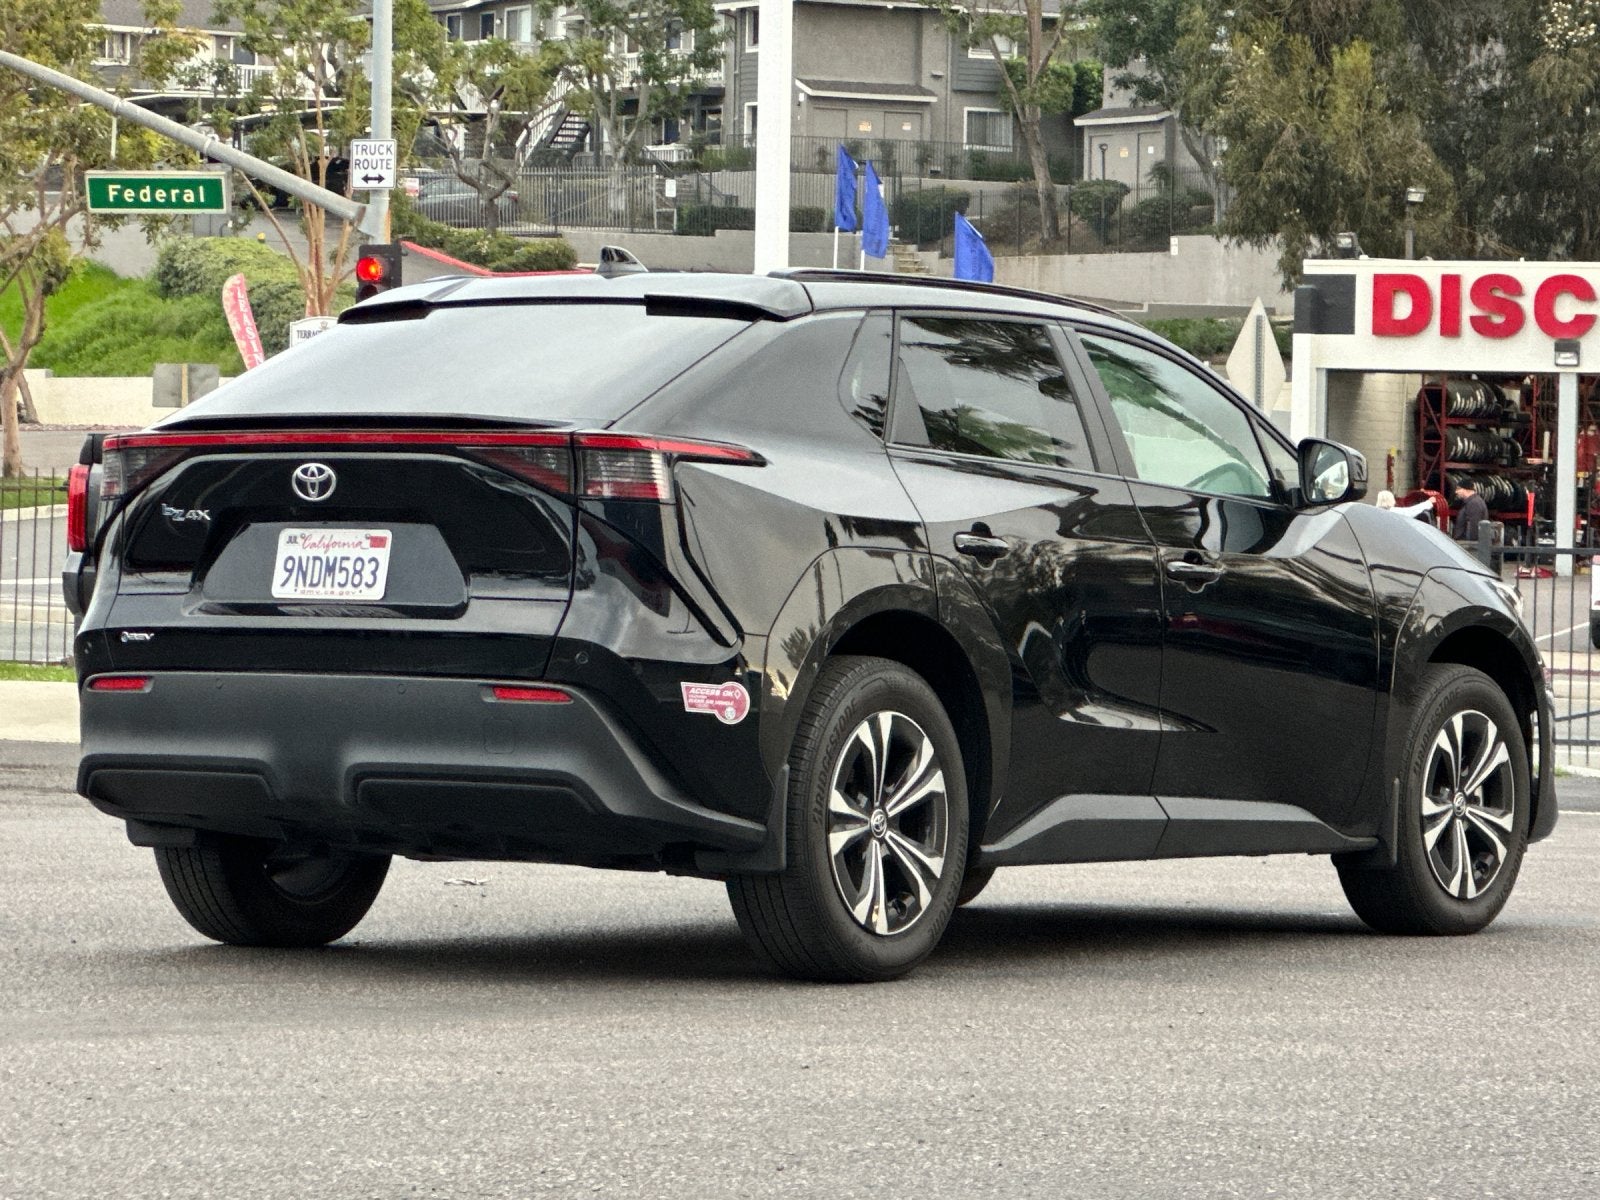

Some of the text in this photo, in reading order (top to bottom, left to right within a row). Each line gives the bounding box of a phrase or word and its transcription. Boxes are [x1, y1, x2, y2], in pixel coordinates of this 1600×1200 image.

[354, 144, 393, 156] TRUCK
[354, 158, 393, 170] ROUTE
[108, 184, 205, 203] Federal
[1372, 273, 1599, 340] DISC
[296, 329, 323, 339] TERRAC
[301, 533, 370, 554] California
[280, 555, 380, 589] 9NDM583
[300, 589, 357, 597] dmv.ca.gov
